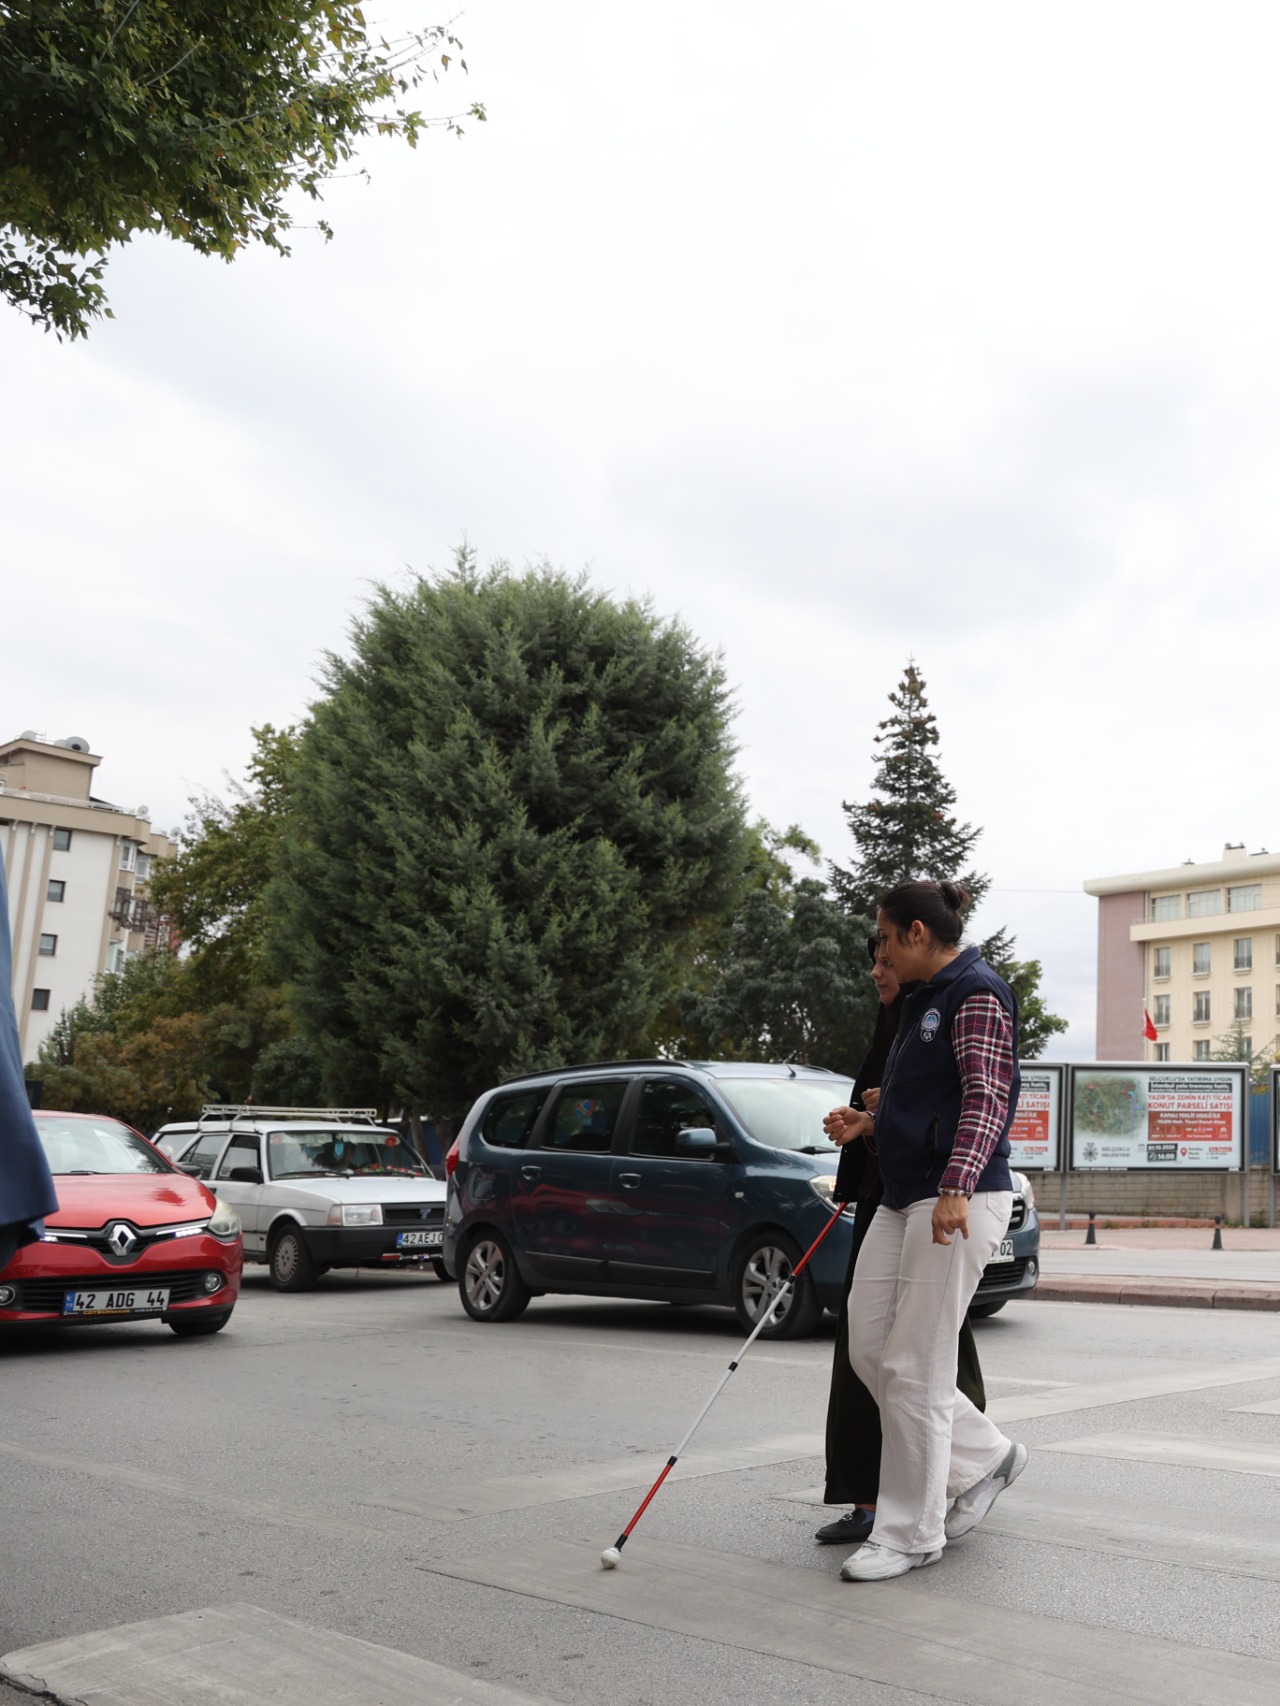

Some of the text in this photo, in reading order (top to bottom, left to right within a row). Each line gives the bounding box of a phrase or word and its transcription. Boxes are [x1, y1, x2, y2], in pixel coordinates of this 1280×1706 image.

[1177, 1101, 1208, 1109] PARSELİ
[1000, 1241, 1012, 1256] 02
[75, 1290, 165, 1309] 42 ADG 44
